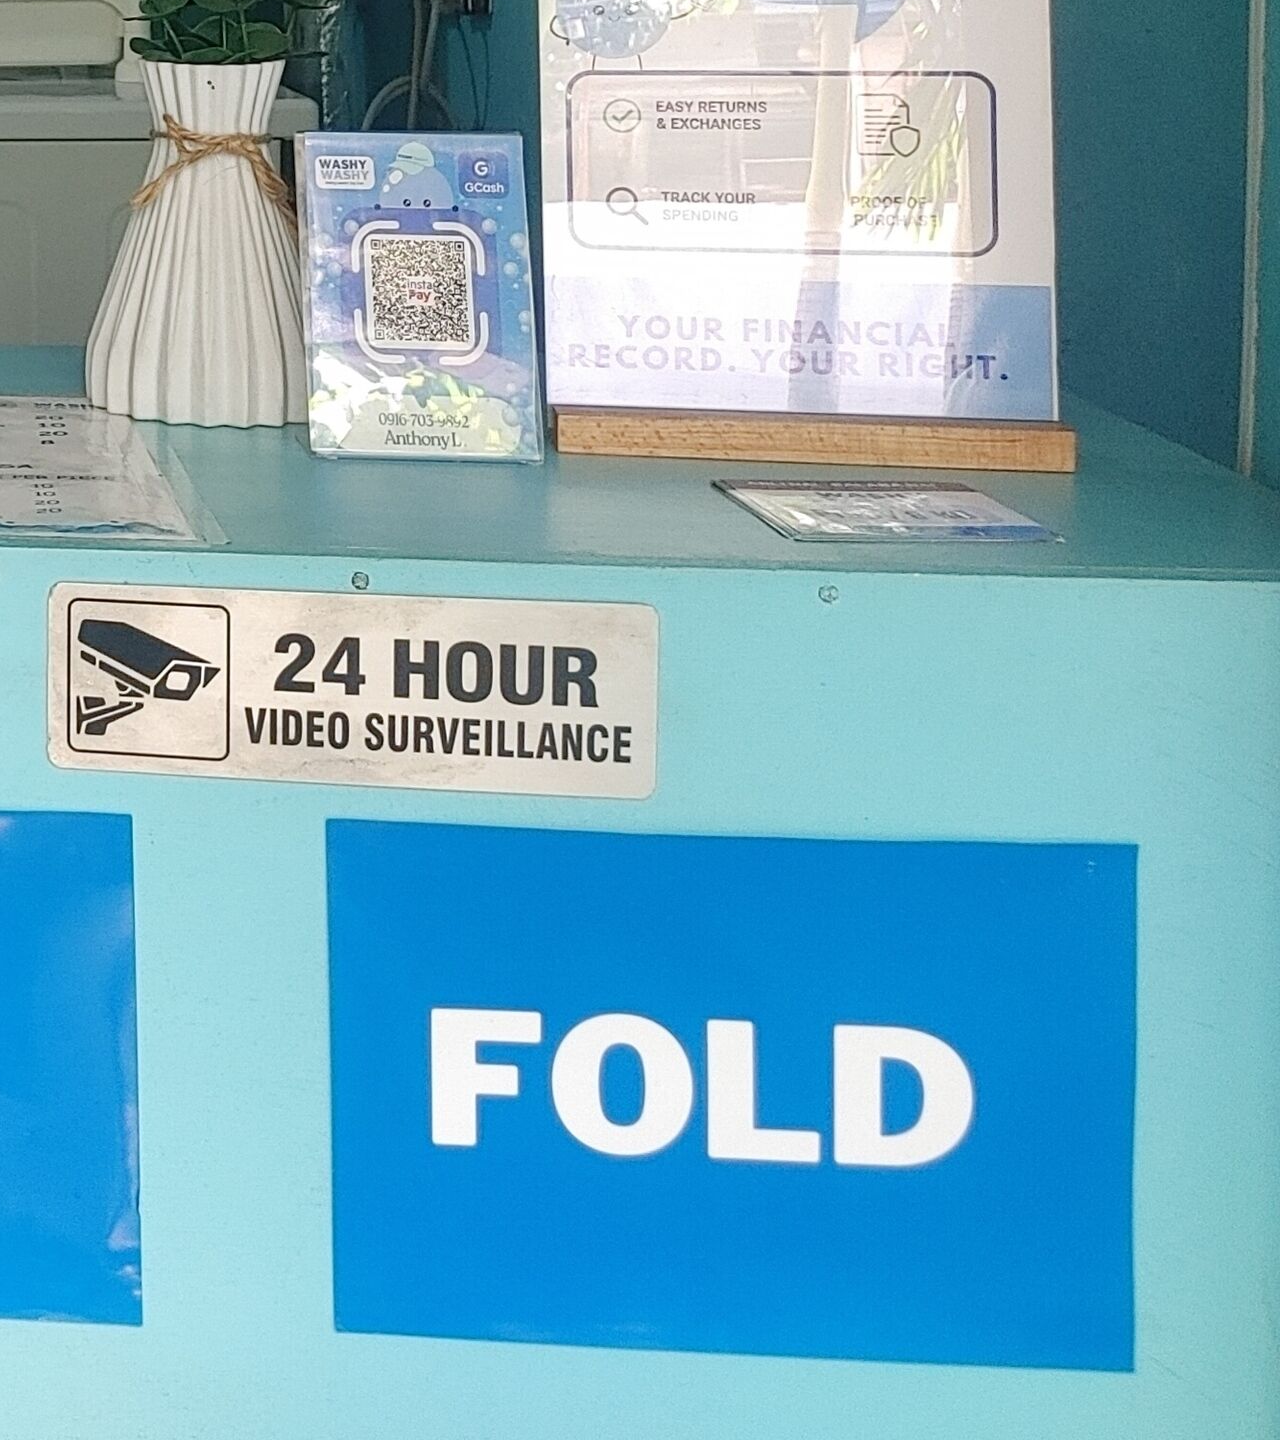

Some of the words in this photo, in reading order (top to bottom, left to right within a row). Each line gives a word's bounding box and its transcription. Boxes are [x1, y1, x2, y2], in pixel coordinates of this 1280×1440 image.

[656, 101, 693, 113] EASY
[698, 101, 767, 114] RETURNS
[656, 118, 667, 130] &
[671, 118, 762, 131] EXCHANGES
[319, 159, 367, 170] WASHY
[321, 170, 370, 181] WASHY
[464, 182, 505, 194] GCash
[661, 191, 711, 204] TRACK
[715, 191, 756, 205] YOUR
[850, 196, 902, 210] PROOF
[907, 197, 927, 210] OF
[662, 209, 739, 223] SPENDING
[407, 290, 432, 303] Pay
[617, 314, 725, 341] YOUR
[743, 318, 956, 348] FINANCIAL
[569, 344, 737, 372] RECORD.
[752, 349, 861, 376] YOUR
[880, 353, 1008, 381] RIGHT.
[384, 430, 451, 450] Anthony
[273, 633, 366, 696] 24
[393, 638, 600, 709] HOUR
[244, 706, 351, 750] VIDEO
[364, 712, 633, 764] SURVEILLANCE
[430, 1007, 975, 1167] FOLD
